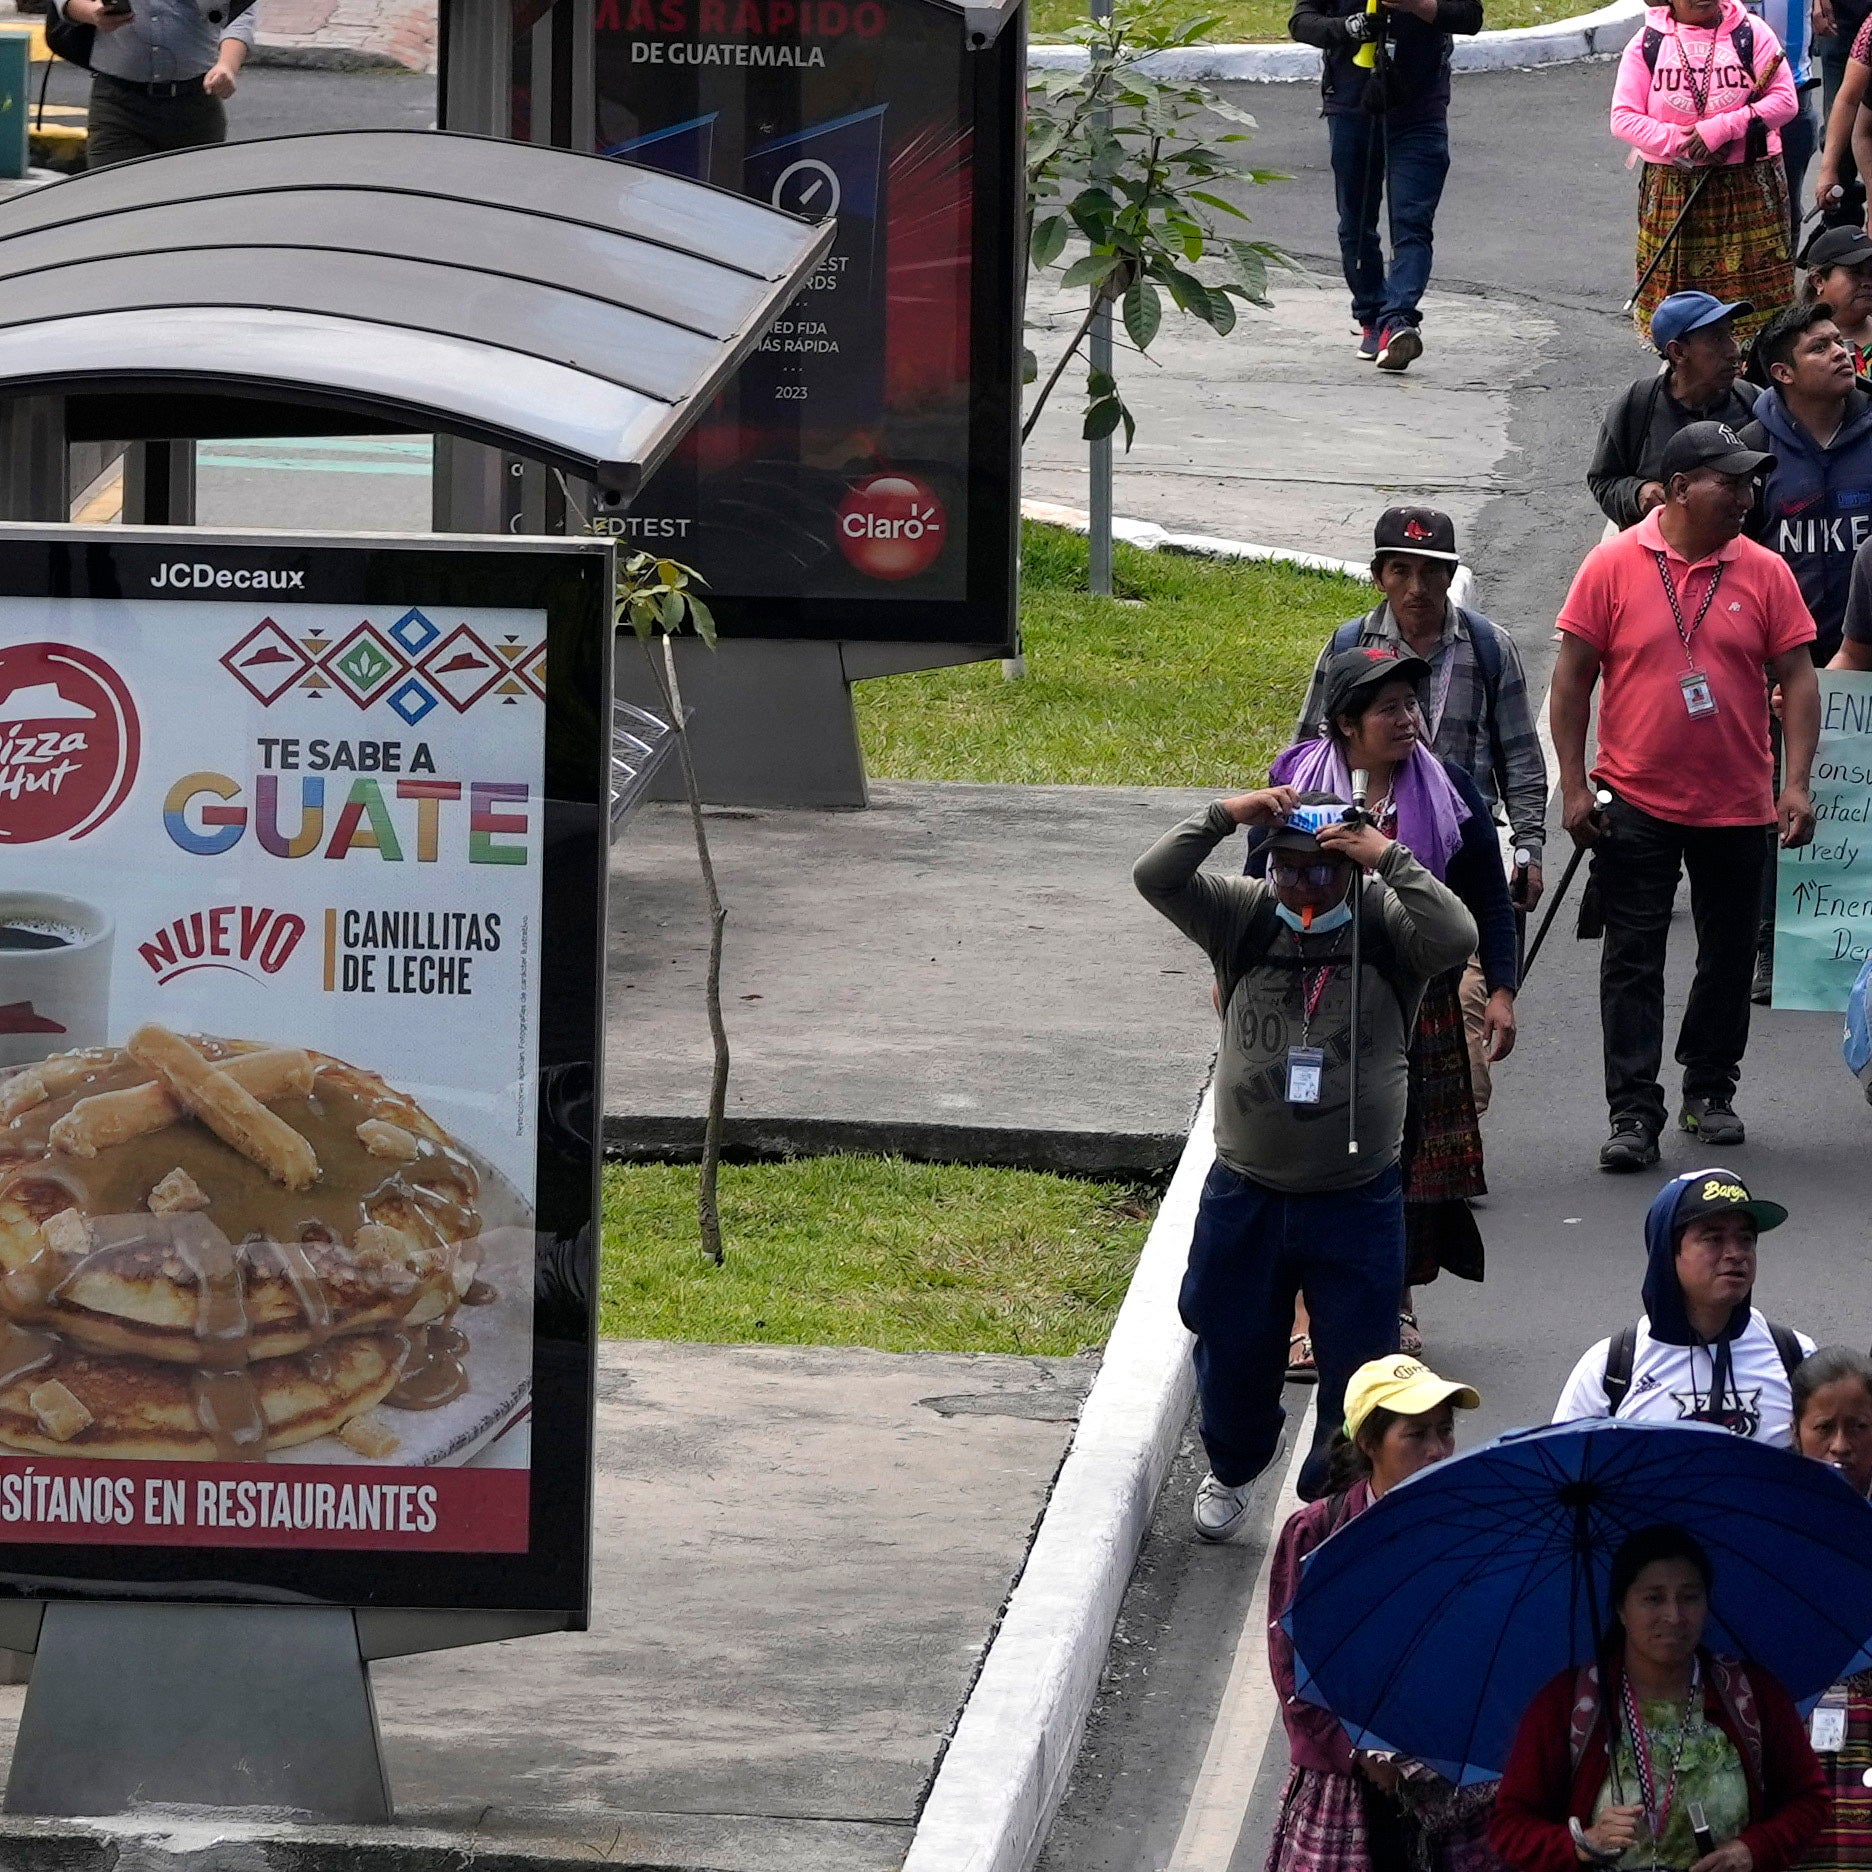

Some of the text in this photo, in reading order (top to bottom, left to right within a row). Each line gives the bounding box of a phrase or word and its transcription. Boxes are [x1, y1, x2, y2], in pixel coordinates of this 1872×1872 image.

[631, 42, 825, 68] DE GUATEMALA
[1653, 65, 1753, 92] JUSTICE
[790, 335, 840, 355] RÁPIDA
[798, 321, 828, 338] FIJA
[775, 385, 808, 400] 2023
[842, 505, 925, 540] Claro
[1779, 514, 1870, 553] NIKE
[150, 562, 305, 589] JCDecaux
[257, 737, 436, 773] TE SABE A
[163, 771, 529, 866] GUATE
[138, 905, 306, 974] NUEVO
[343, 909, 500, 951] CANILLITAS
[343, 955, 472, 994] DE LECHE
[145, 1479, 185, 1525] EN
[197, 1480, 437, 1533] RESTAURANTES
